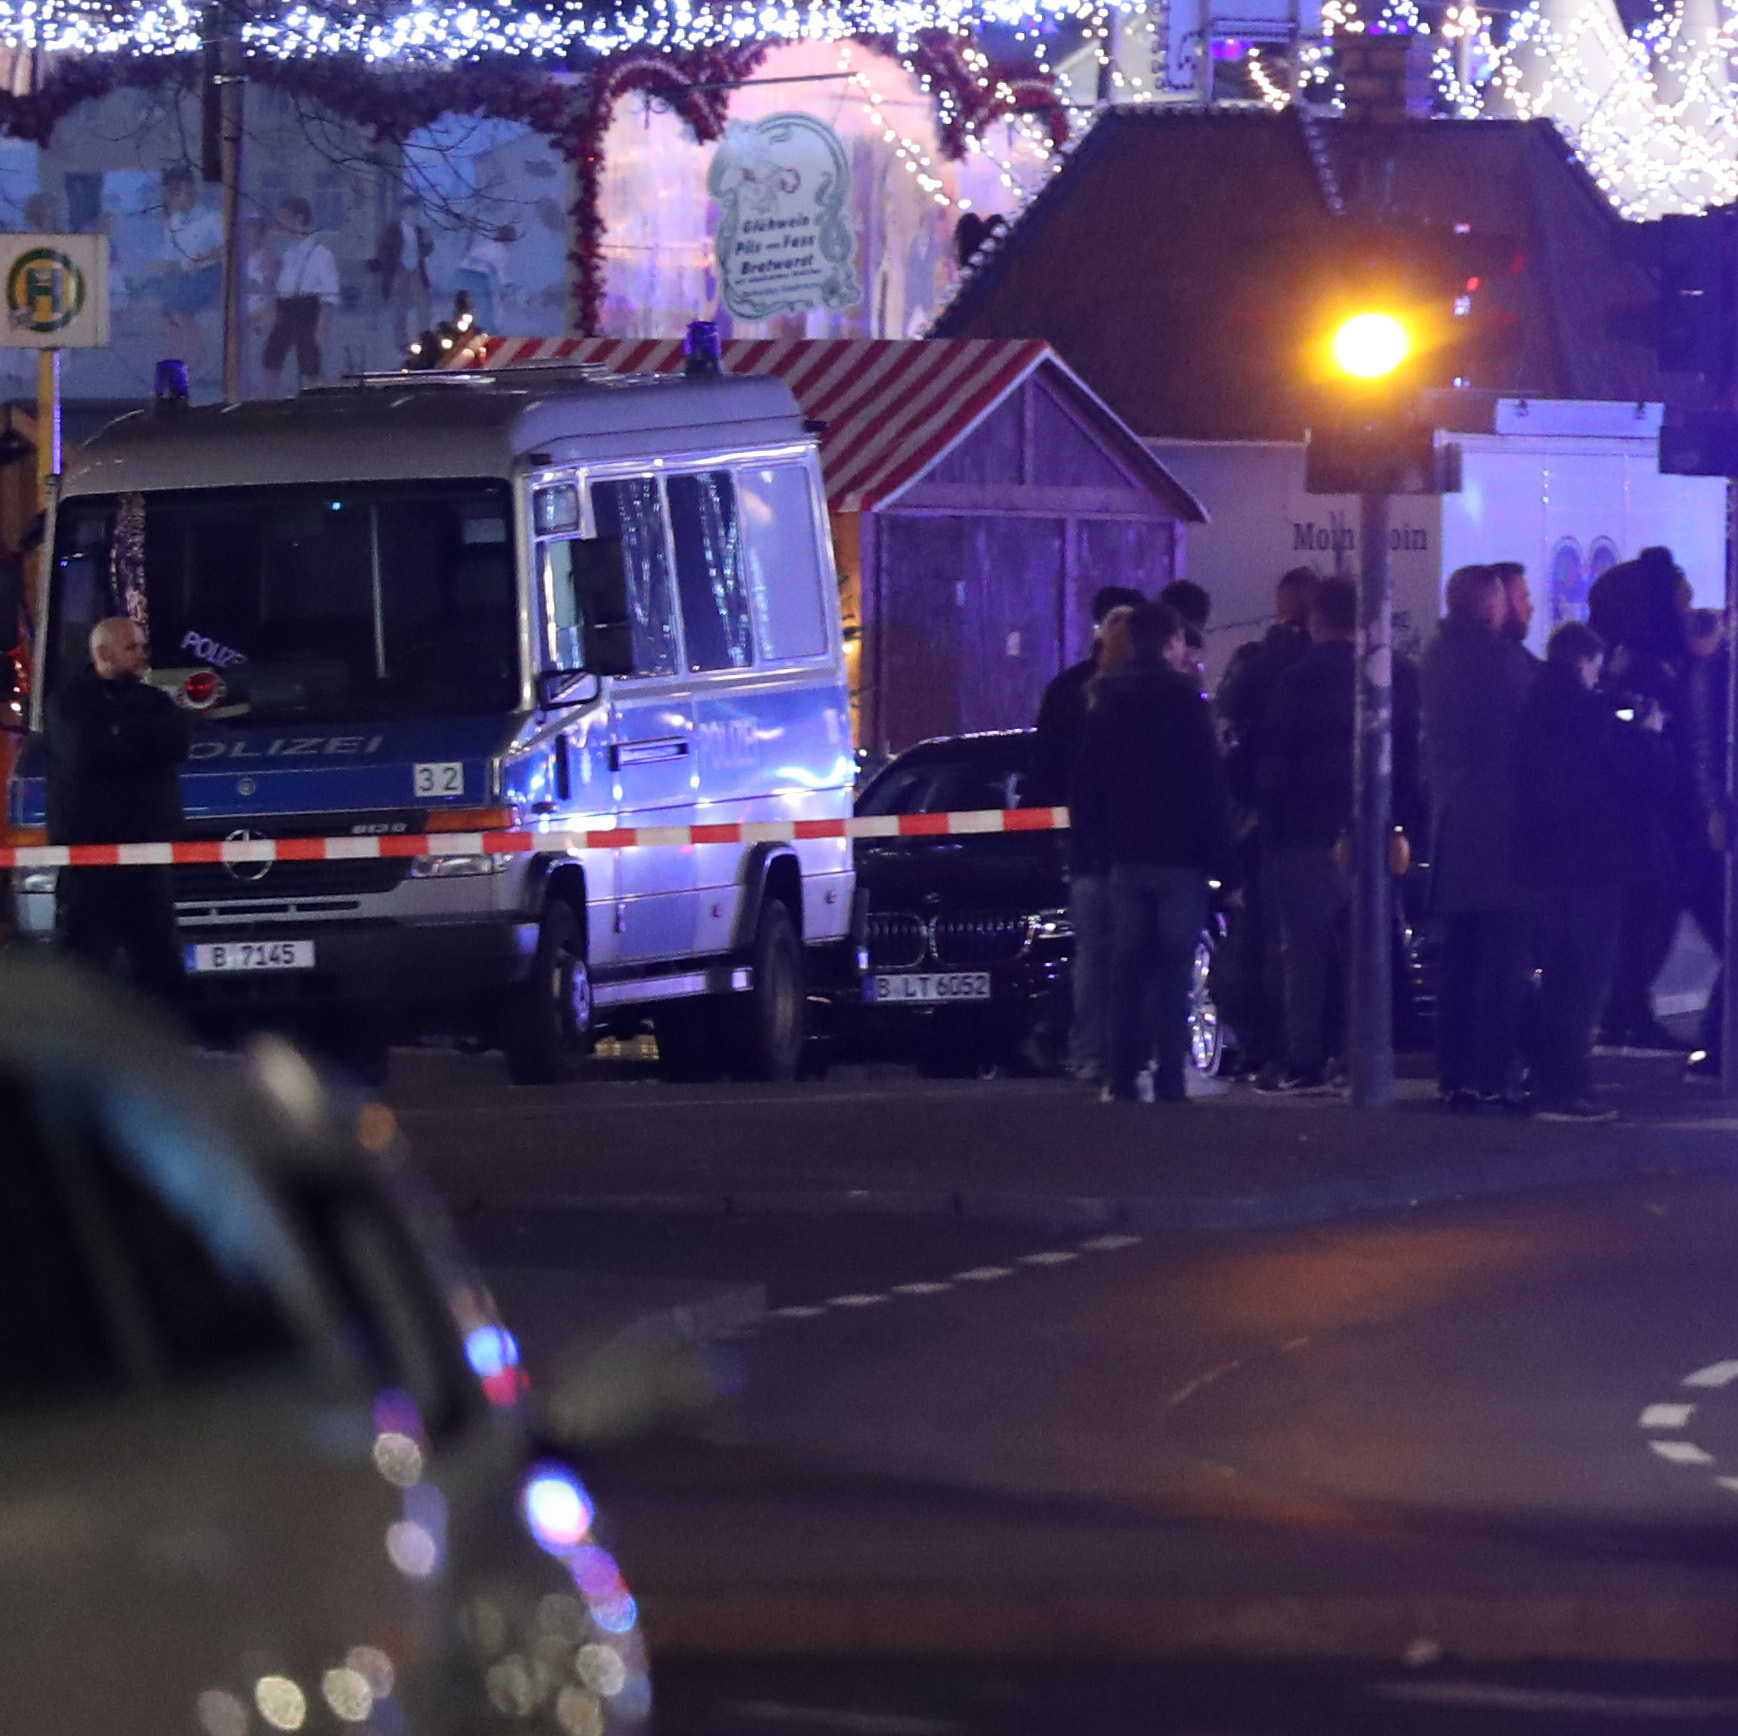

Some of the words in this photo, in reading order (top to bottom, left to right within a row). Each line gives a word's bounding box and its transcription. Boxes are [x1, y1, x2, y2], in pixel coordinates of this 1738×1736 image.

[188, 735, 385, 760] OLIZEI
[418, 766, 460, 792] 32
[213, 946, 226, 967] B
[242, 944, 295, 967] 7145
